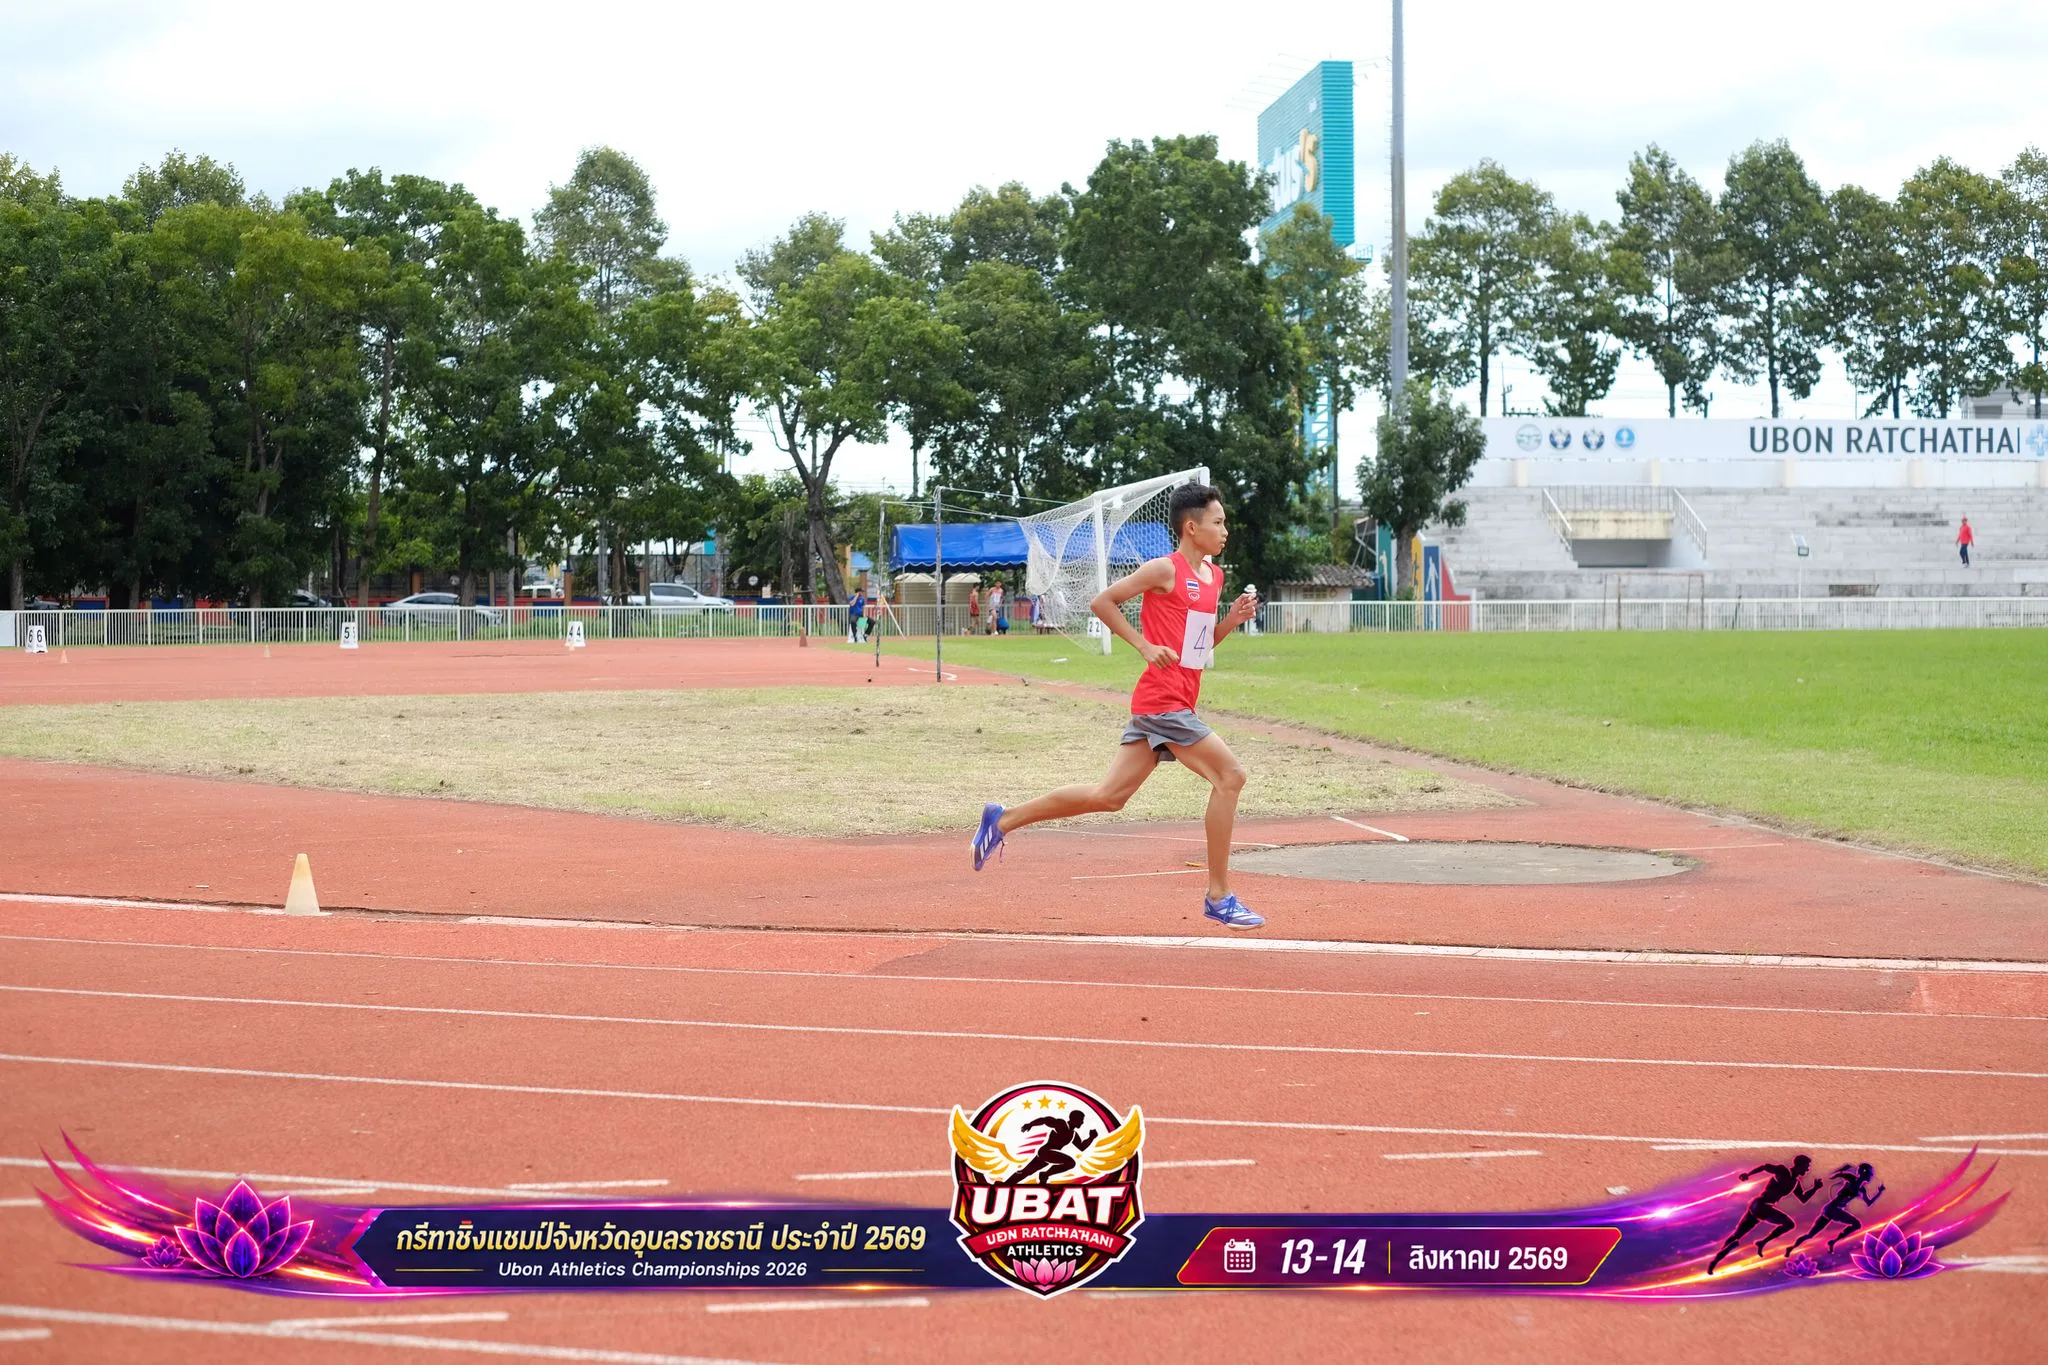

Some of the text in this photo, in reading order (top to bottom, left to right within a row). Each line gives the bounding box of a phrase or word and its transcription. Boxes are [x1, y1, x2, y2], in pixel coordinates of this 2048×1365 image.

[1749, 426, 1833, 454] UBON
[36, 629, 43, 643] 6
[344, 626, 350, 639] 5
[1193, 624, 1207, 658] 4
